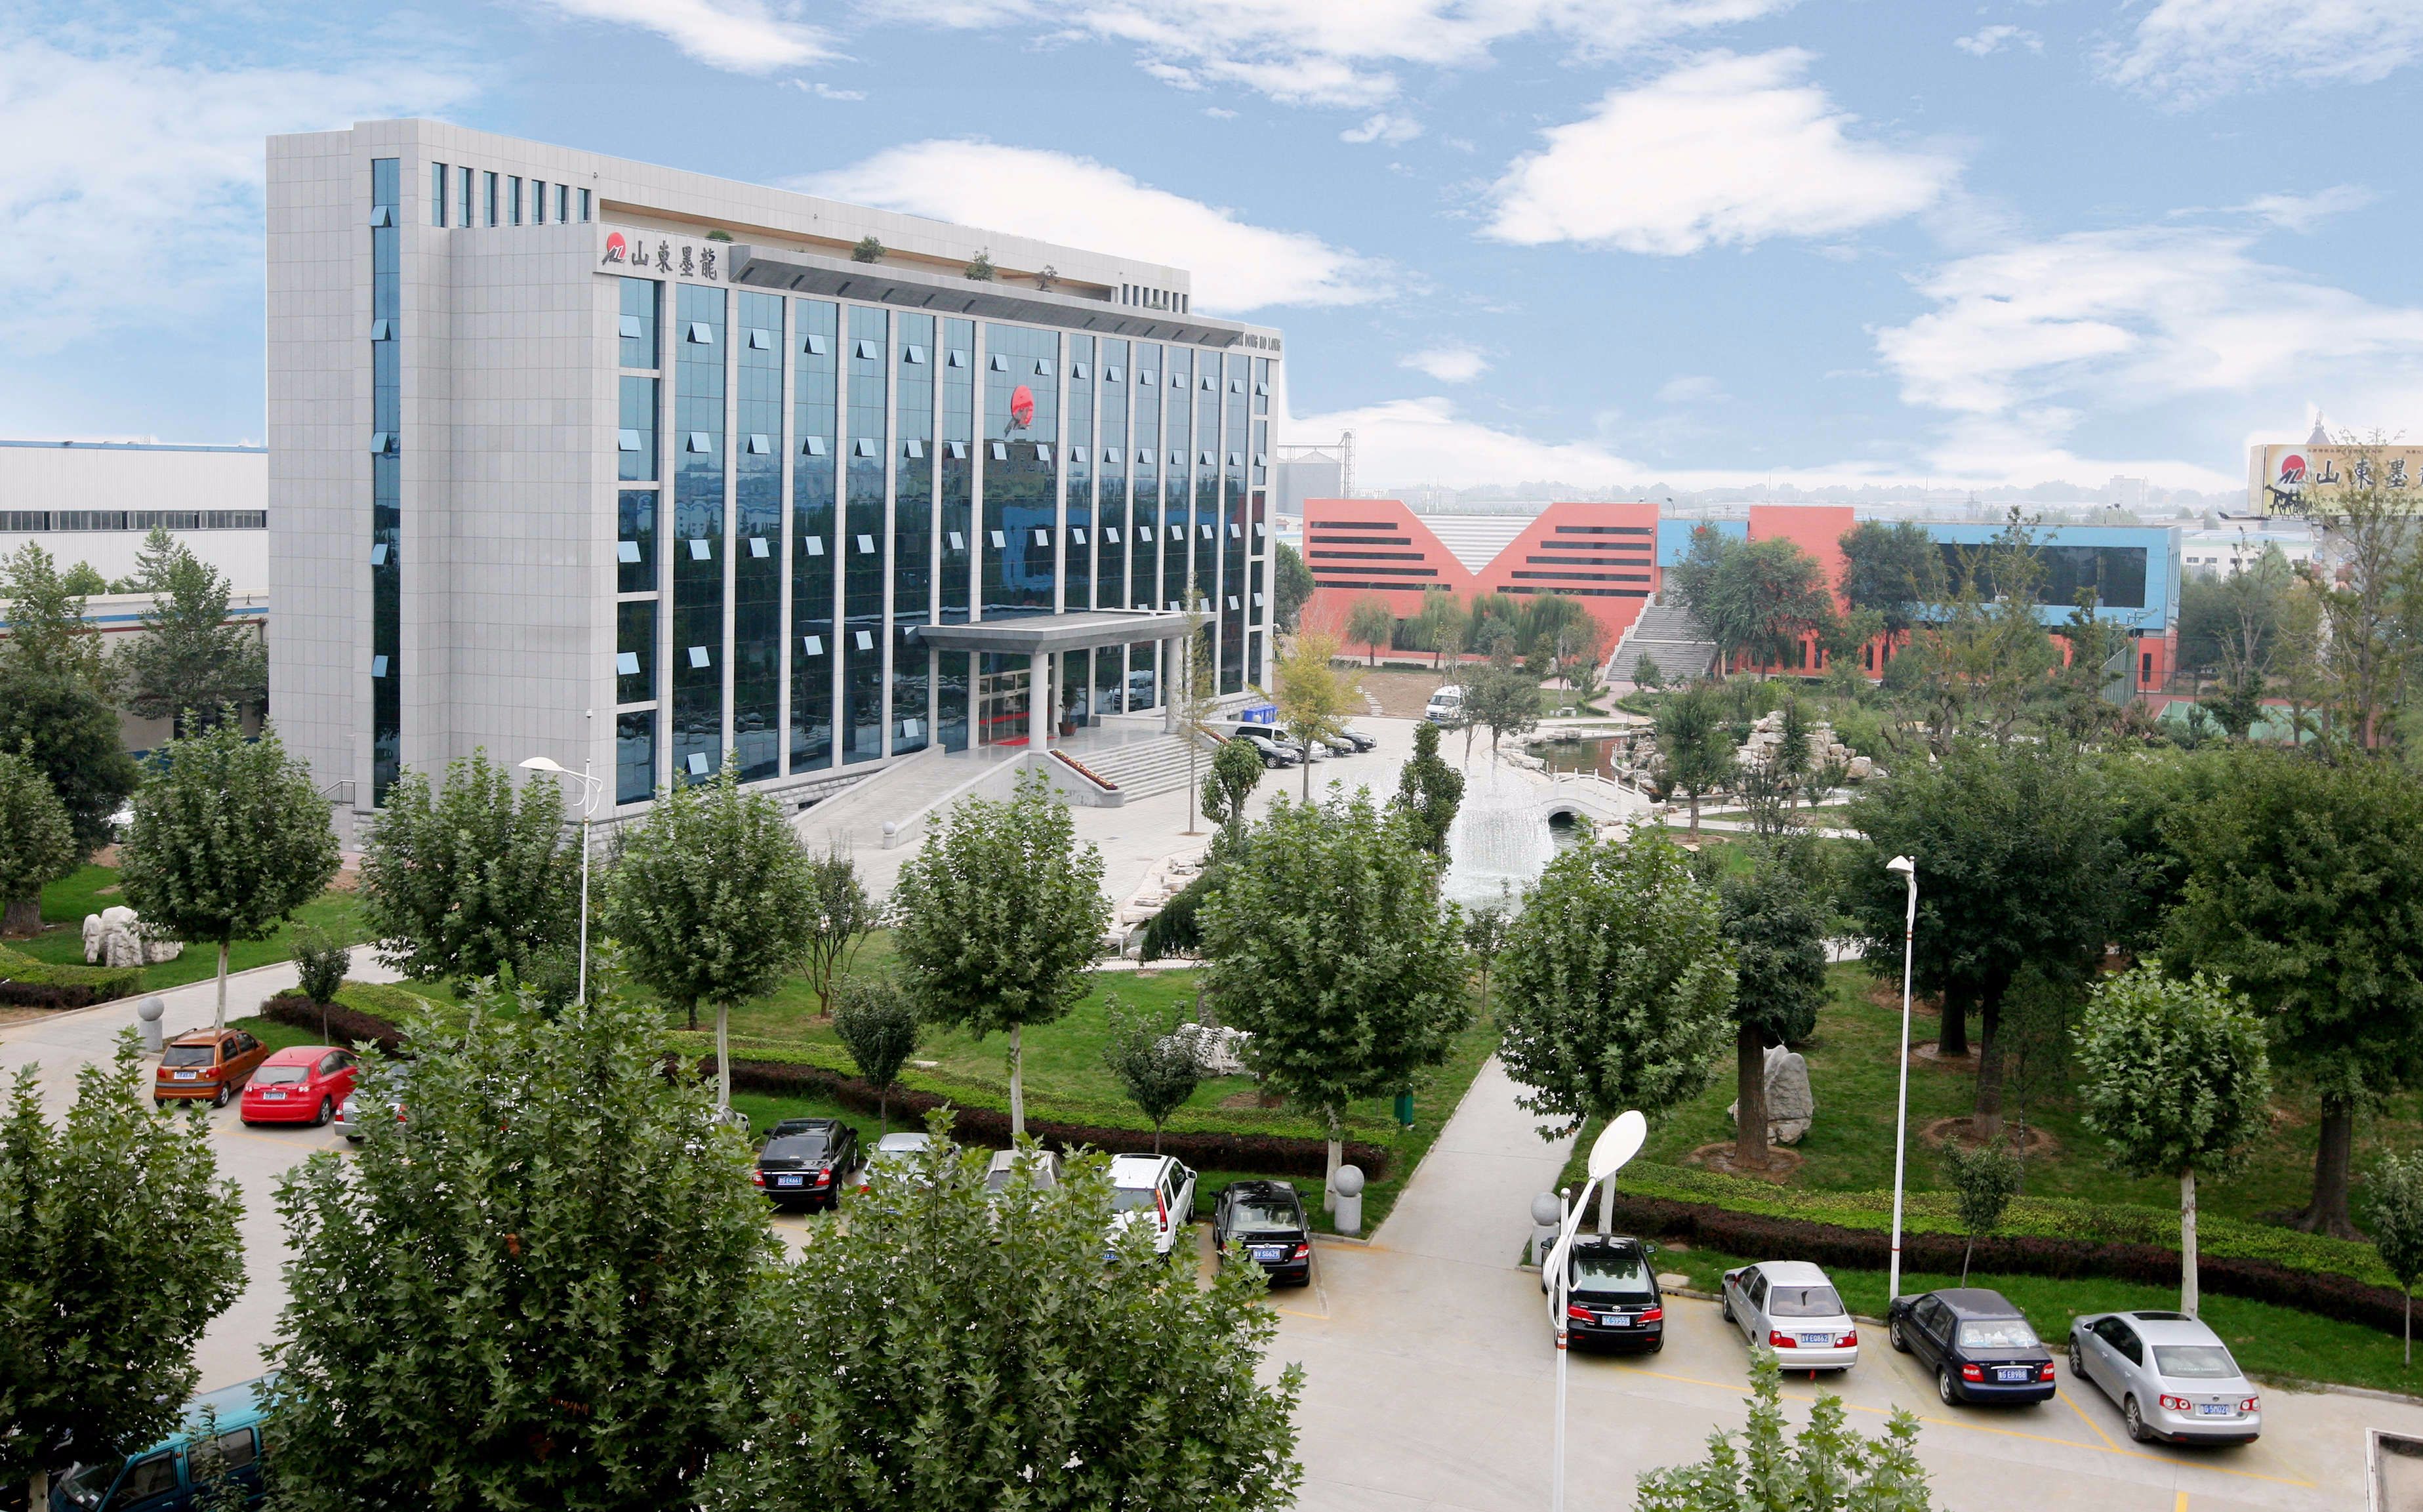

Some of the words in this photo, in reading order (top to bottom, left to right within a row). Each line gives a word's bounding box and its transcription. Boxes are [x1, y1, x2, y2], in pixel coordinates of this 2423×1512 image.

[632, 240, 717, 280] 山東墨龍
[2316, 459, 2423, 489] 山東墨
